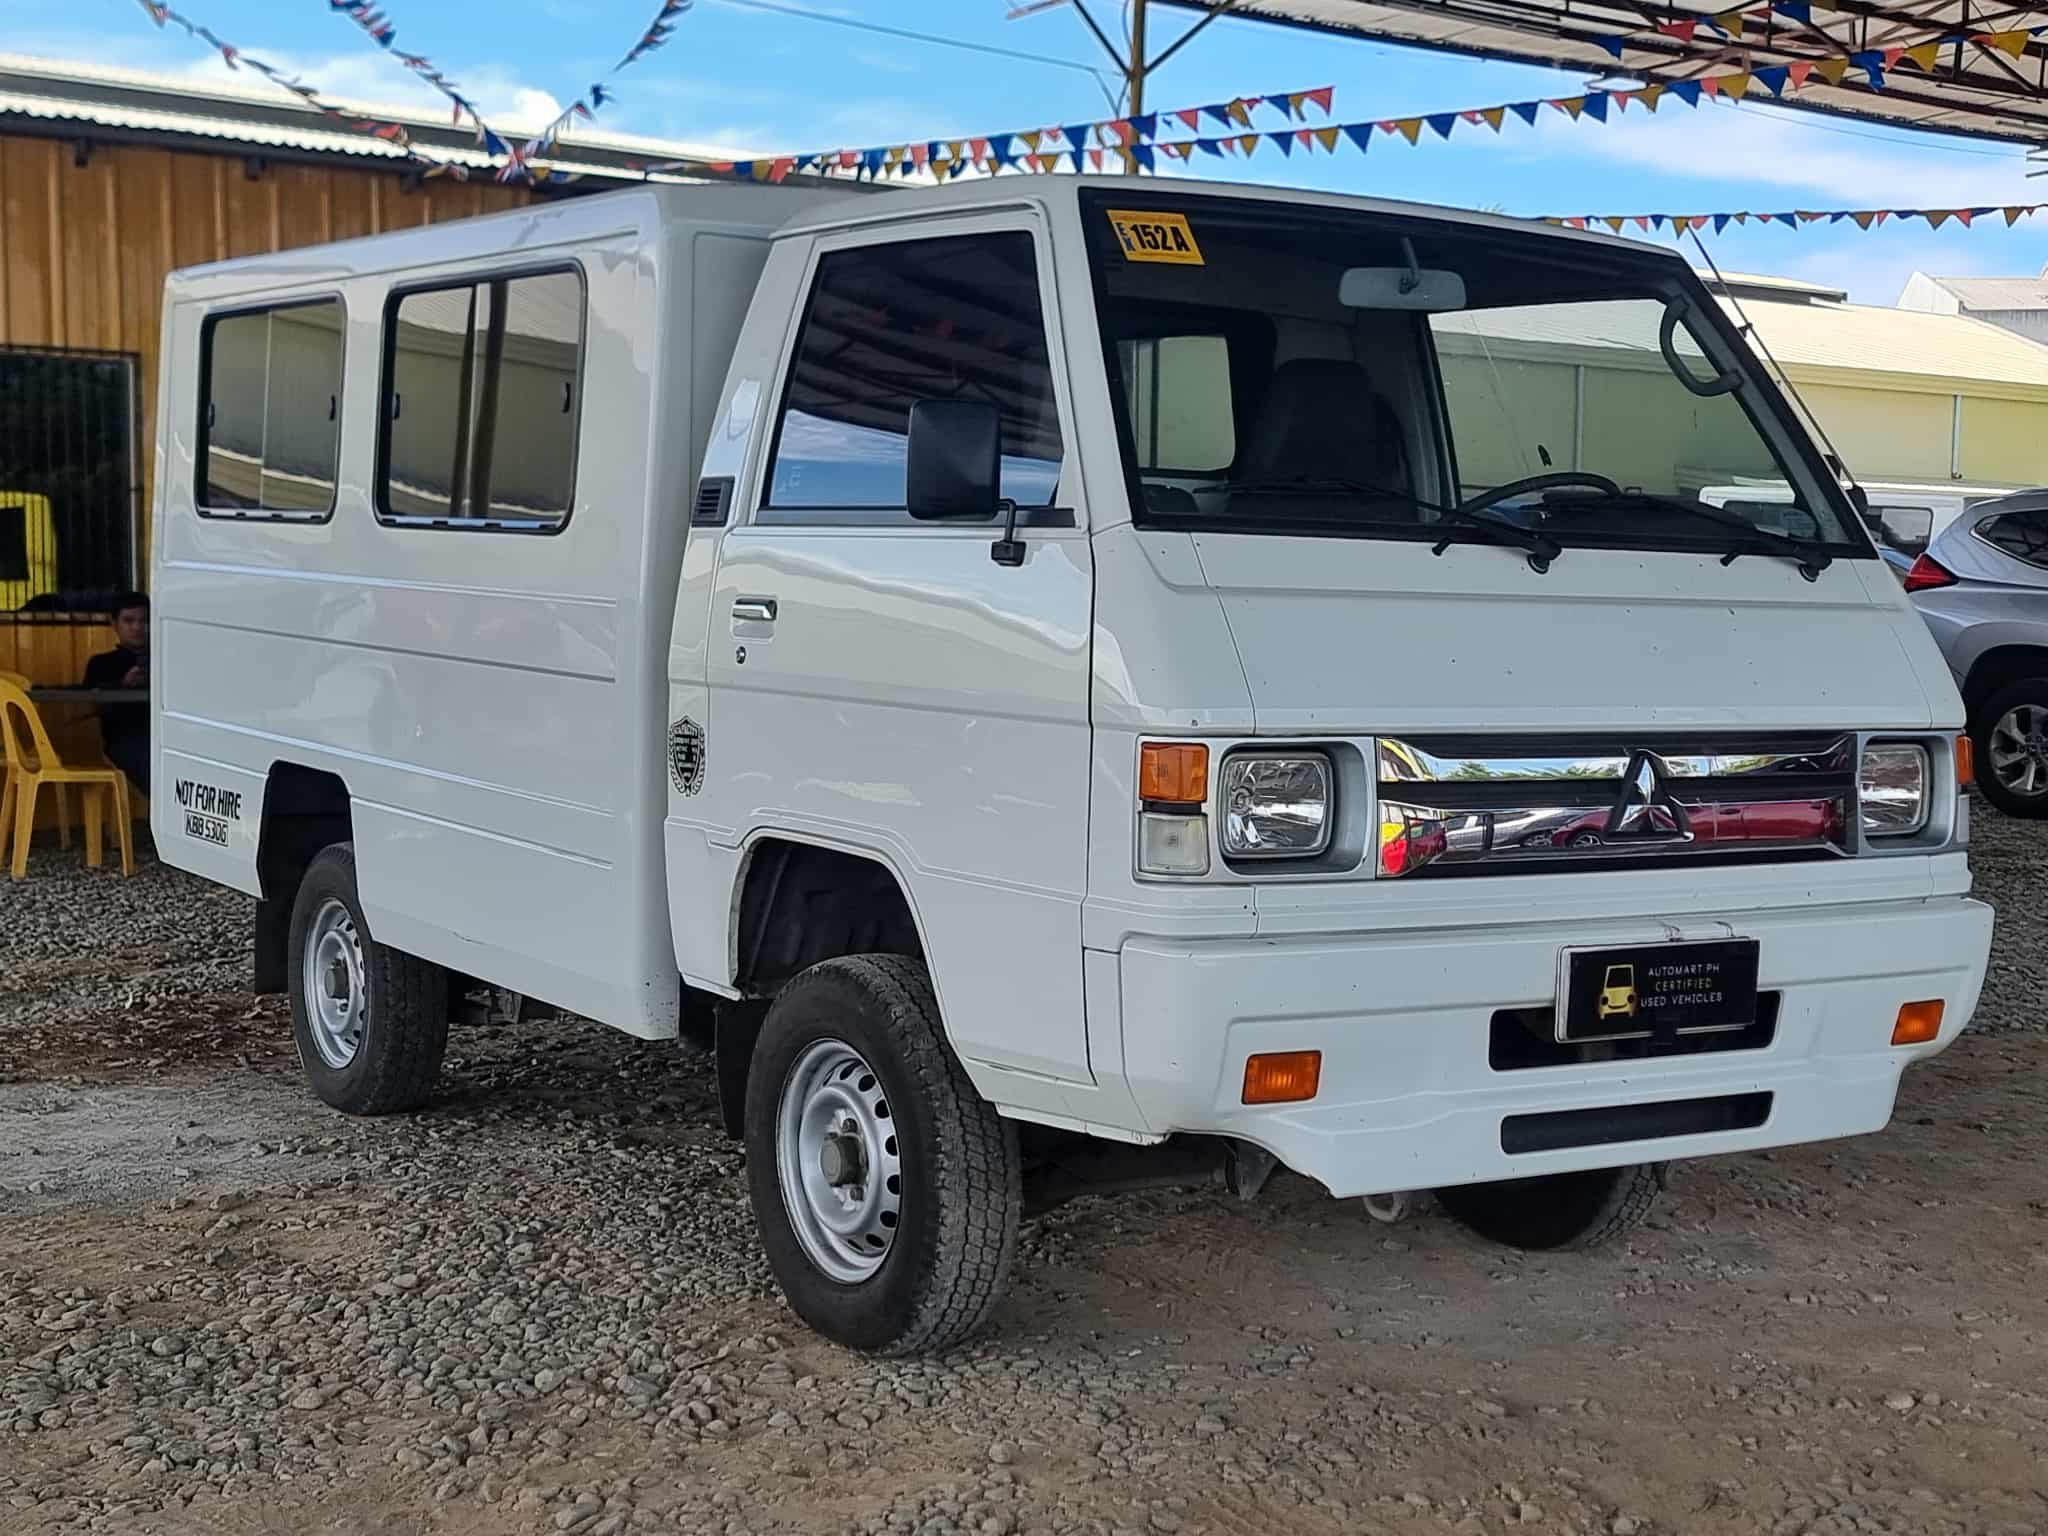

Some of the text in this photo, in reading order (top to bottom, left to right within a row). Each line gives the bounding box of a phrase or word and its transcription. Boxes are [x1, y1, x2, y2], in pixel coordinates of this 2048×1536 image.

[1129, 223, 1191, 252] 152A
[175, 777, 242, 820] NOT FOR HIRE
[186, 814, 204, 836] KBB
[1655, 977, 1712, 992] CERTIFIED
[1640, 991, 1722, 1008] USED VEHICLES
